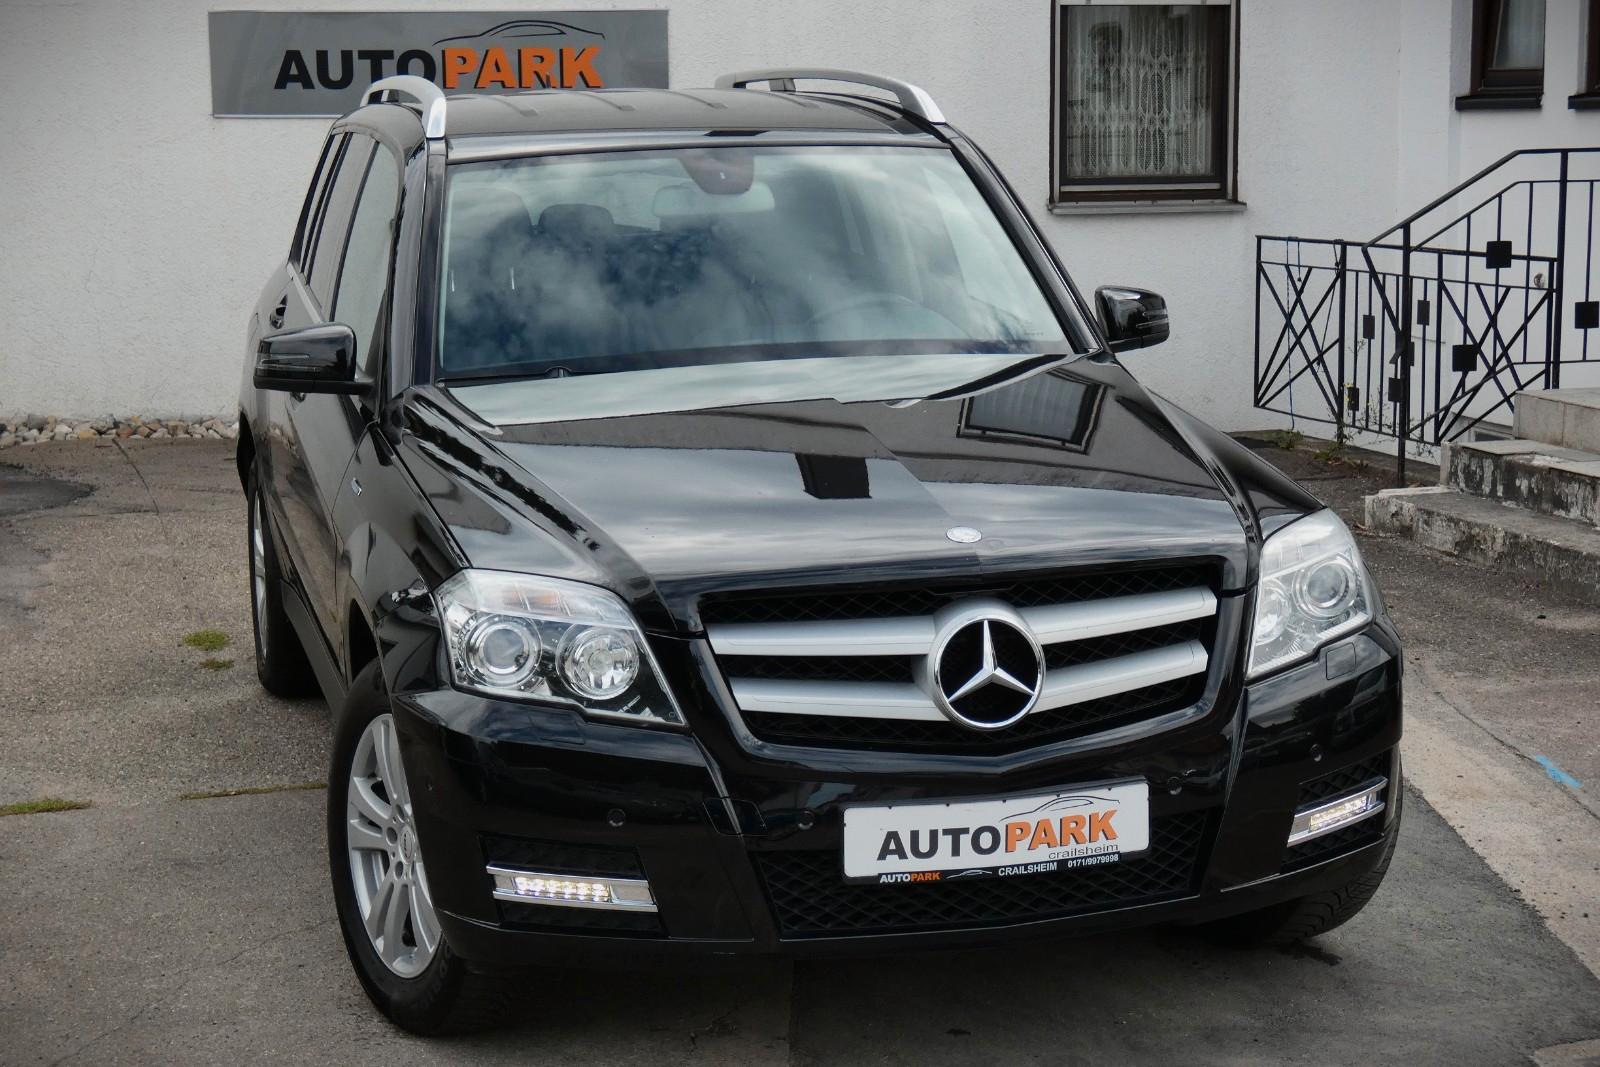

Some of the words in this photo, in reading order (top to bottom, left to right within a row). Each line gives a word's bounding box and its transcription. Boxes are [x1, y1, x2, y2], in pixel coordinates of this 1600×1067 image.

[274, 45, 604, 90] AUTOPARK
[877, 809, 1119, 861] AUTOPARK
[1048, 843, 1119, 860] crailsheim
[880, 872, 940, 883] AUTOPARK
[998, 862, 1057, 876] CRAILSHEIM
